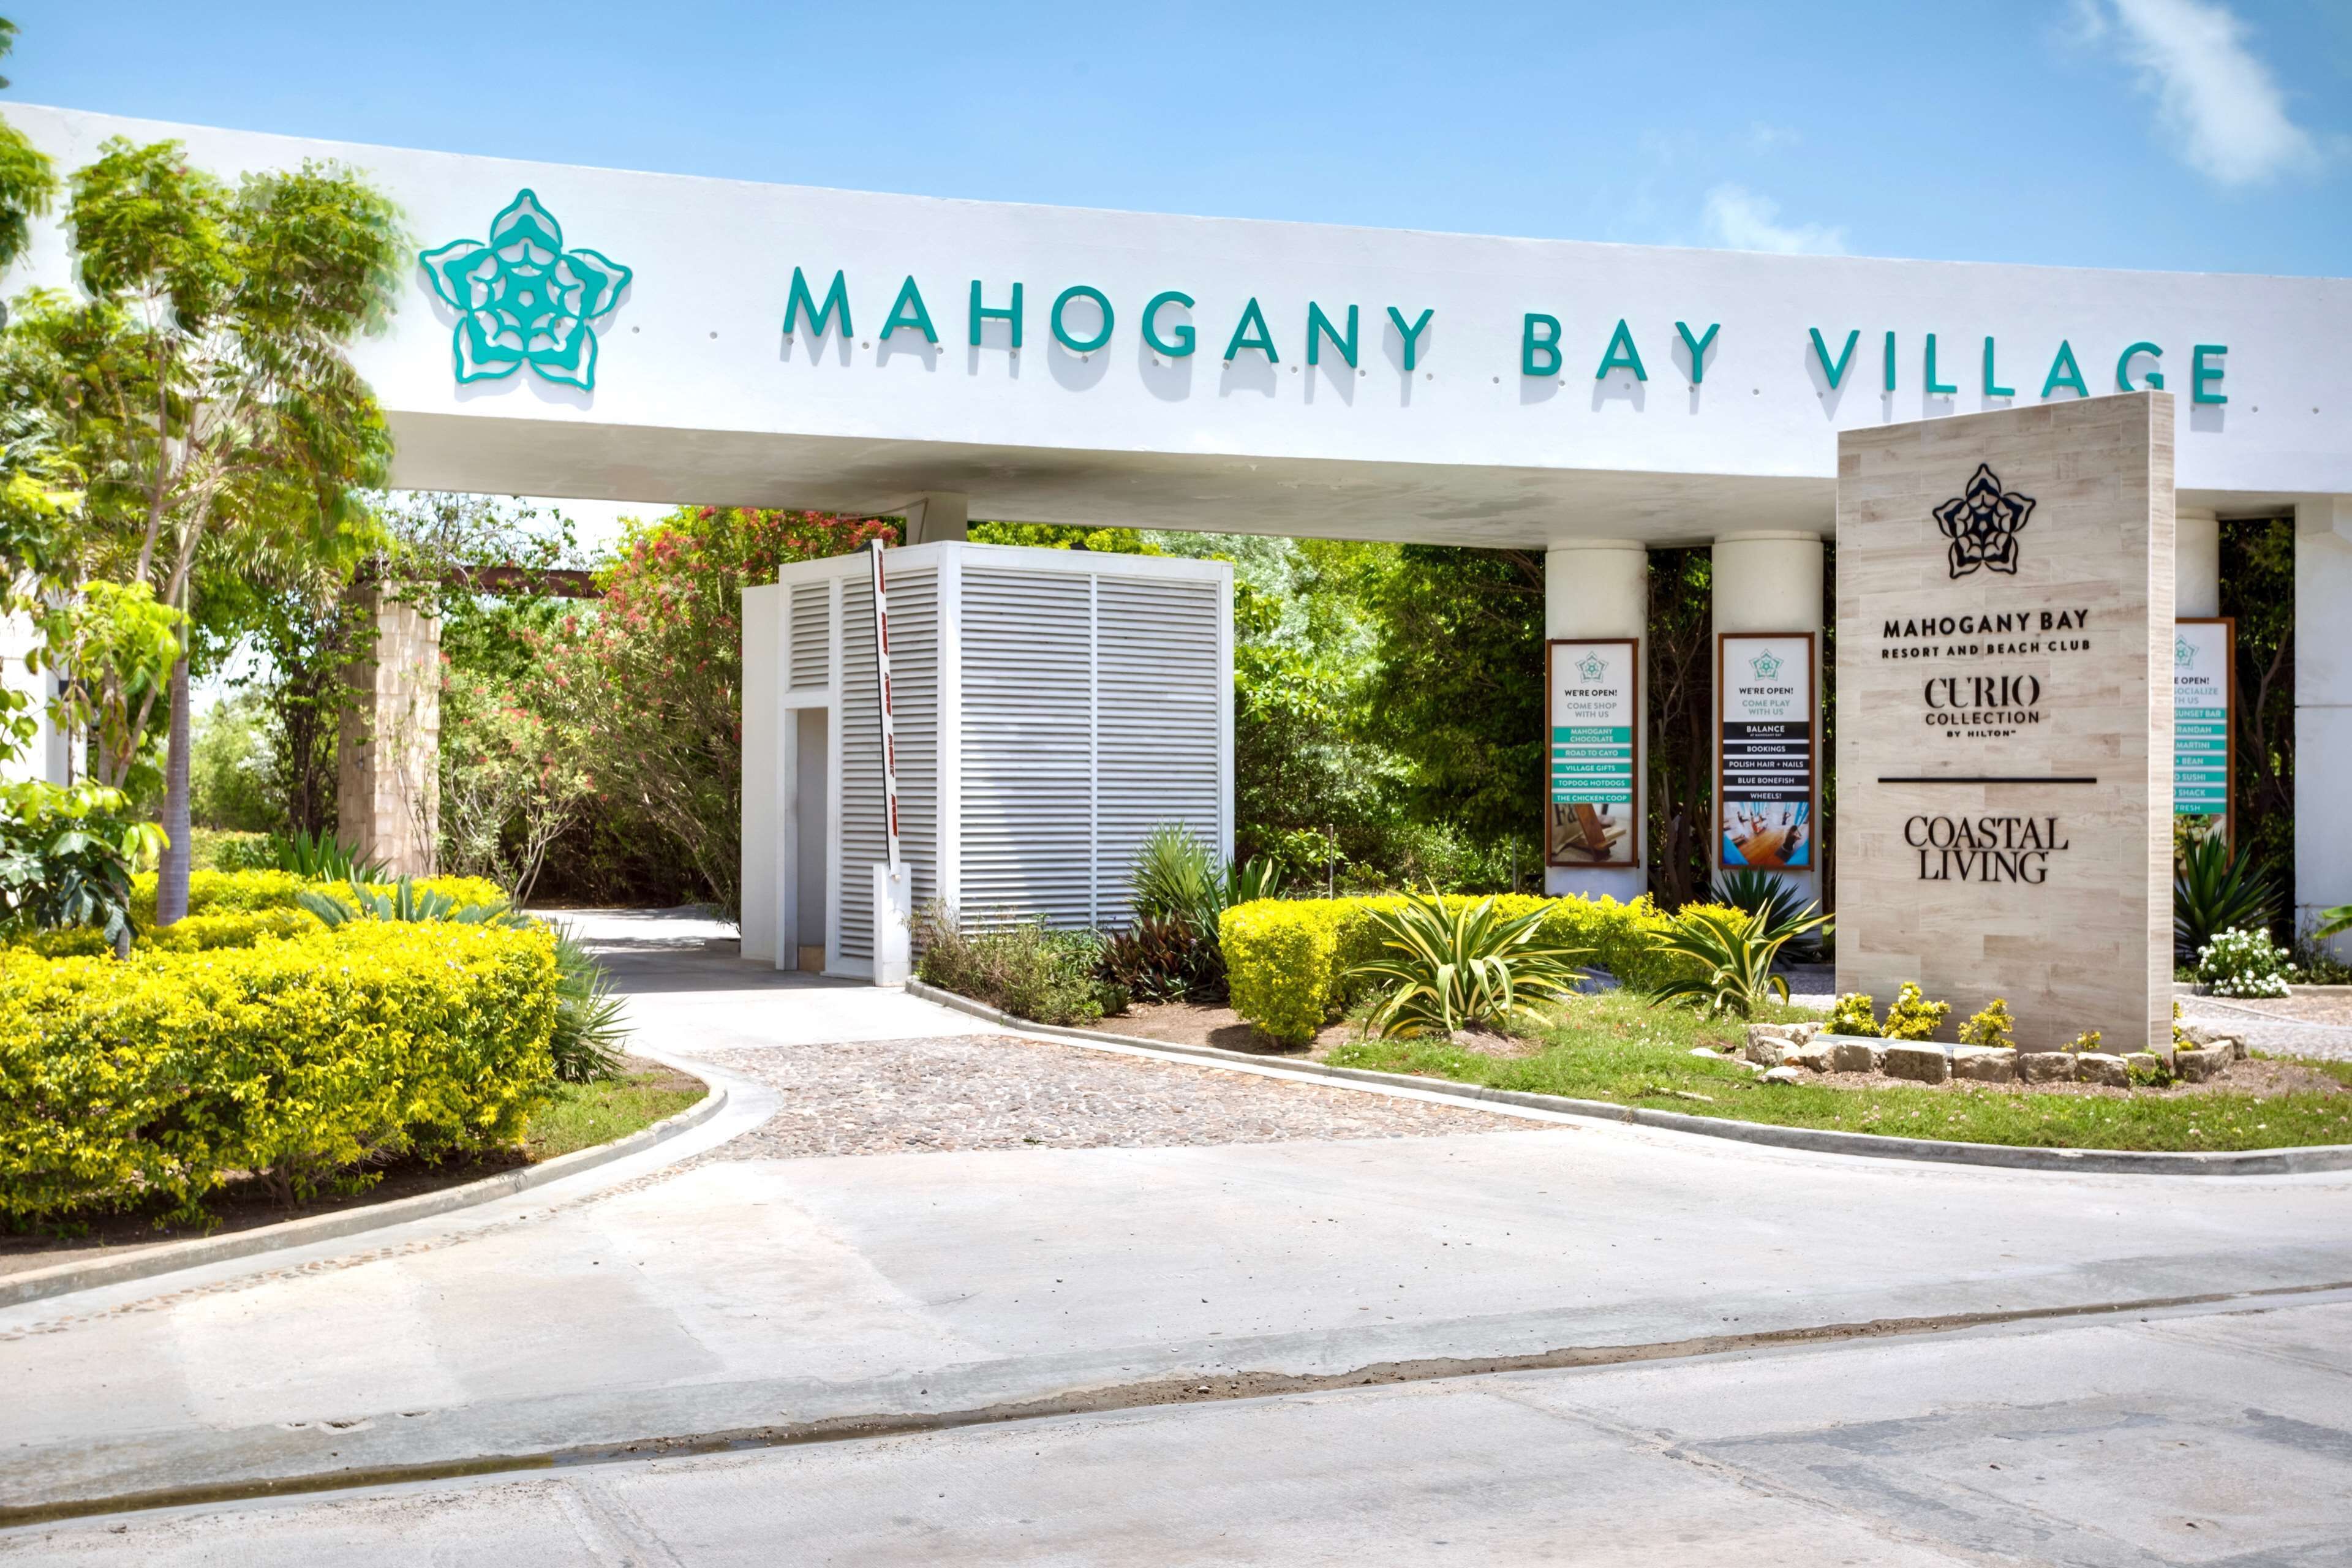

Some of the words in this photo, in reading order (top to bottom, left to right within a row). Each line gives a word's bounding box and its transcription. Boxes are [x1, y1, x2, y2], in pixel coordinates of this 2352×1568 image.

[783, 266, 1434, 371] MAHOGANY
[1523, 313, 1720, 383] BAY
[1809, 328, 2228, 404] VILLAGE
[1883, 612, 2030, 638] MAHOGANY
[2040, 609, 2089, 631] BAY
[1882, 646, 1939, 659] RESORT
[1947, 645, 1978, 656] AND
[1987, 642, 2040, 655] BEACH
[2048, 639, 2090, 652] CLUB
[1924, 675, 2040, 709] CURIO
[1925, 711, 2039, 726] COLLECTION
[1904, 816, 2069, 850] COASTAL
[1918, 849, 2049, 884] LIVING
